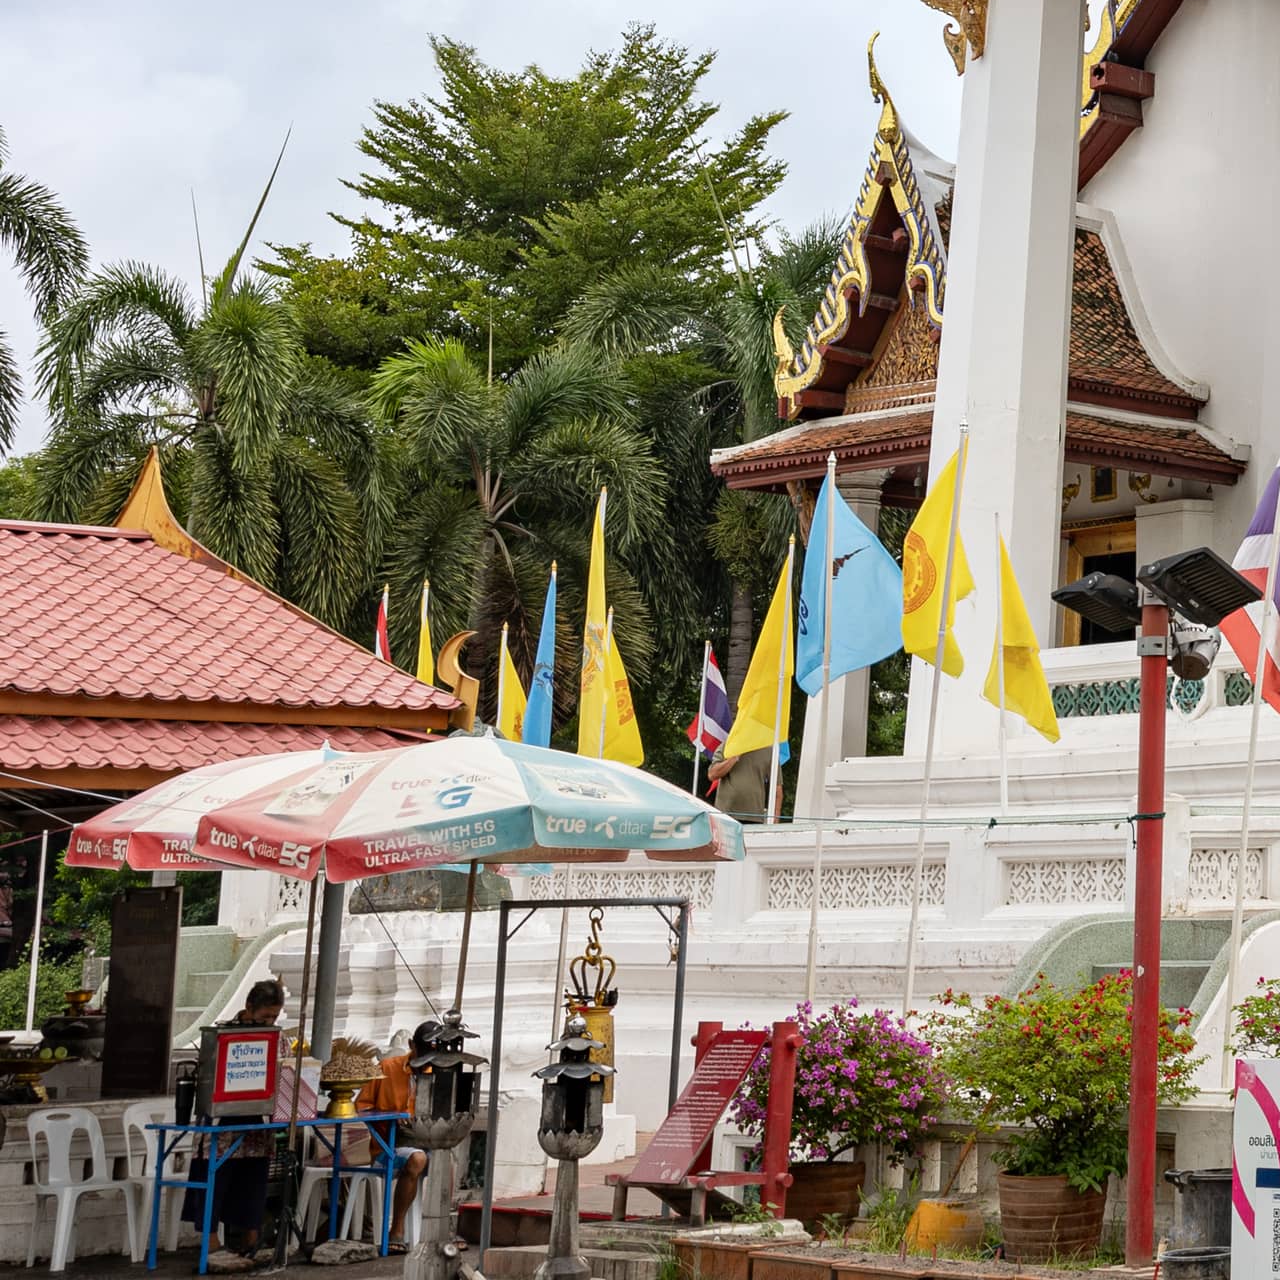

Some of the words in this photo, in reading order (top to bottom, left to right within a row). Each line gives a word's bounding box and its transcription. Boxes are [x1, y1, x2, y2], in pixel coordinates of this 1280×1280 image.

[363, 835, 428, 854] TRAVEL
[430, 823, 471, 842] WITH
[474, 820, 496, 835] 5G
[546, 815, 587, 834] true
[618, 821, 648, 836] dtac
[650, 815, 694, 839] 5G
[76, 837, 93, 854] true
[162, 839, 195, 852] TRA
[209, 827, 238, 850] true
[278, 840, 312, 870] 5G
[365, 843, 450, 868] ULTRA-FAST
[451, 834, 497, 853] SPEED
[1248, 1134, 1277, 1147] ออมสิน
